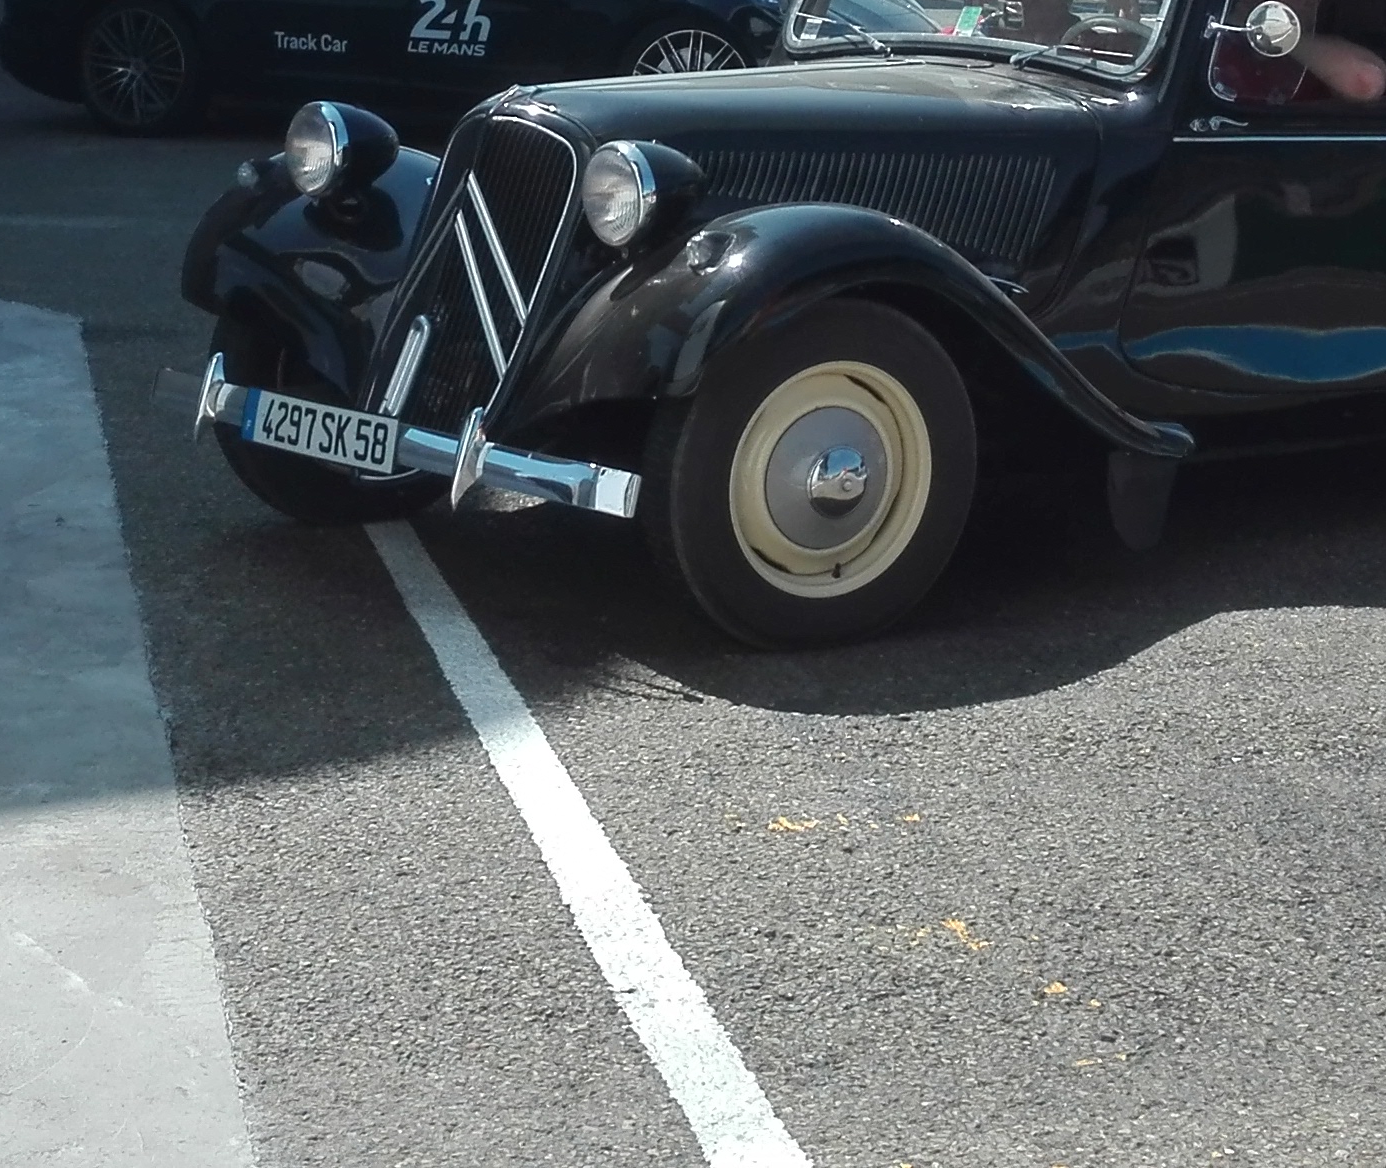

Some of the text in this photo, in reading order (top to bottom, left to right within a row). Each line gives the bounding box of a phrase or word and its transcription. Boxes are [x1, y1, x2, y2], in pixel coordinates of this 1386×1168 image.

[274, 31, 349, 53] Track Car
[407, 40, 486, 57] LE MANS
[262, 399, 389, 465] 4297 SK 58
